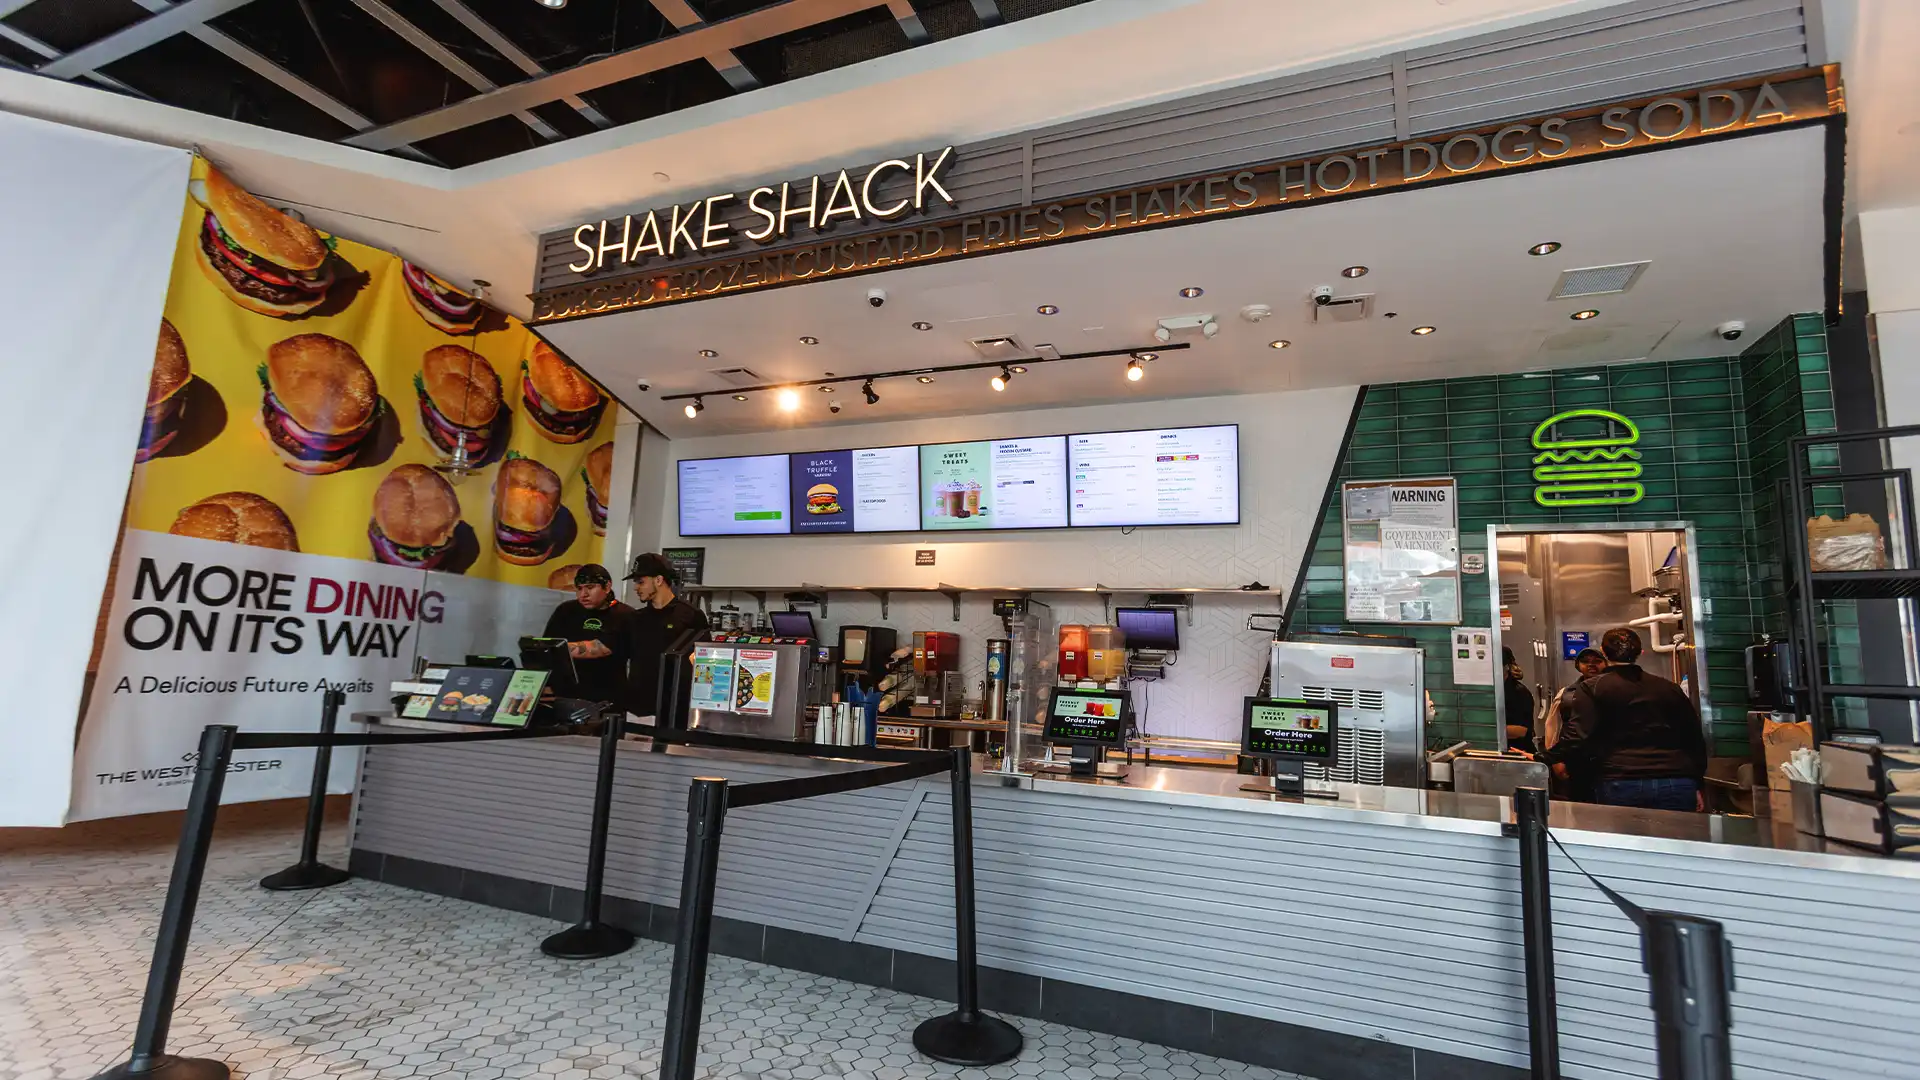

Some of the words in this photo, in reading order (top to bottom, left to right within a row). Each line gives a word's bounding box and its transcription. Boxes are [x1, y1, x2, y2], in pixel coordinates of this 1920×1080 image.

[665, 253, 785, 299] FROZEN
[790, 226, 945, 278] CUSTARD
[961, 203, 1065, 253] FRIES
[1084, 171, 1258, 231] SHAKES
[1279, 147, 1389, 201] HOT
[1402, 117, 1573, 182] DOGS
[1601, 80, 1797, 148] SODA
[569, 193, 735, 273] SHAKE
[745, 146, 955, 240] SHACK
[1385, 530, 1452, 540] GOVERNMENT
[1394, 541, 1443, 550] WARNING:
[132, 557, 296, 611] MORE
[305, 577, 446, 624] DINING
[123, 606, 220, 652] ON
[228, 613, 305, 655] ITS
[317, 619, 411, 658] WAY
[114, 676, 132, 694] A
[139, 676, 238, 694] Delicious
[243, 677, 309, 694] Future
[314, 678, 374, 694] Awaits
[1264, 729, 1290, 737] Order
[96, 770, 137, 785] THE
